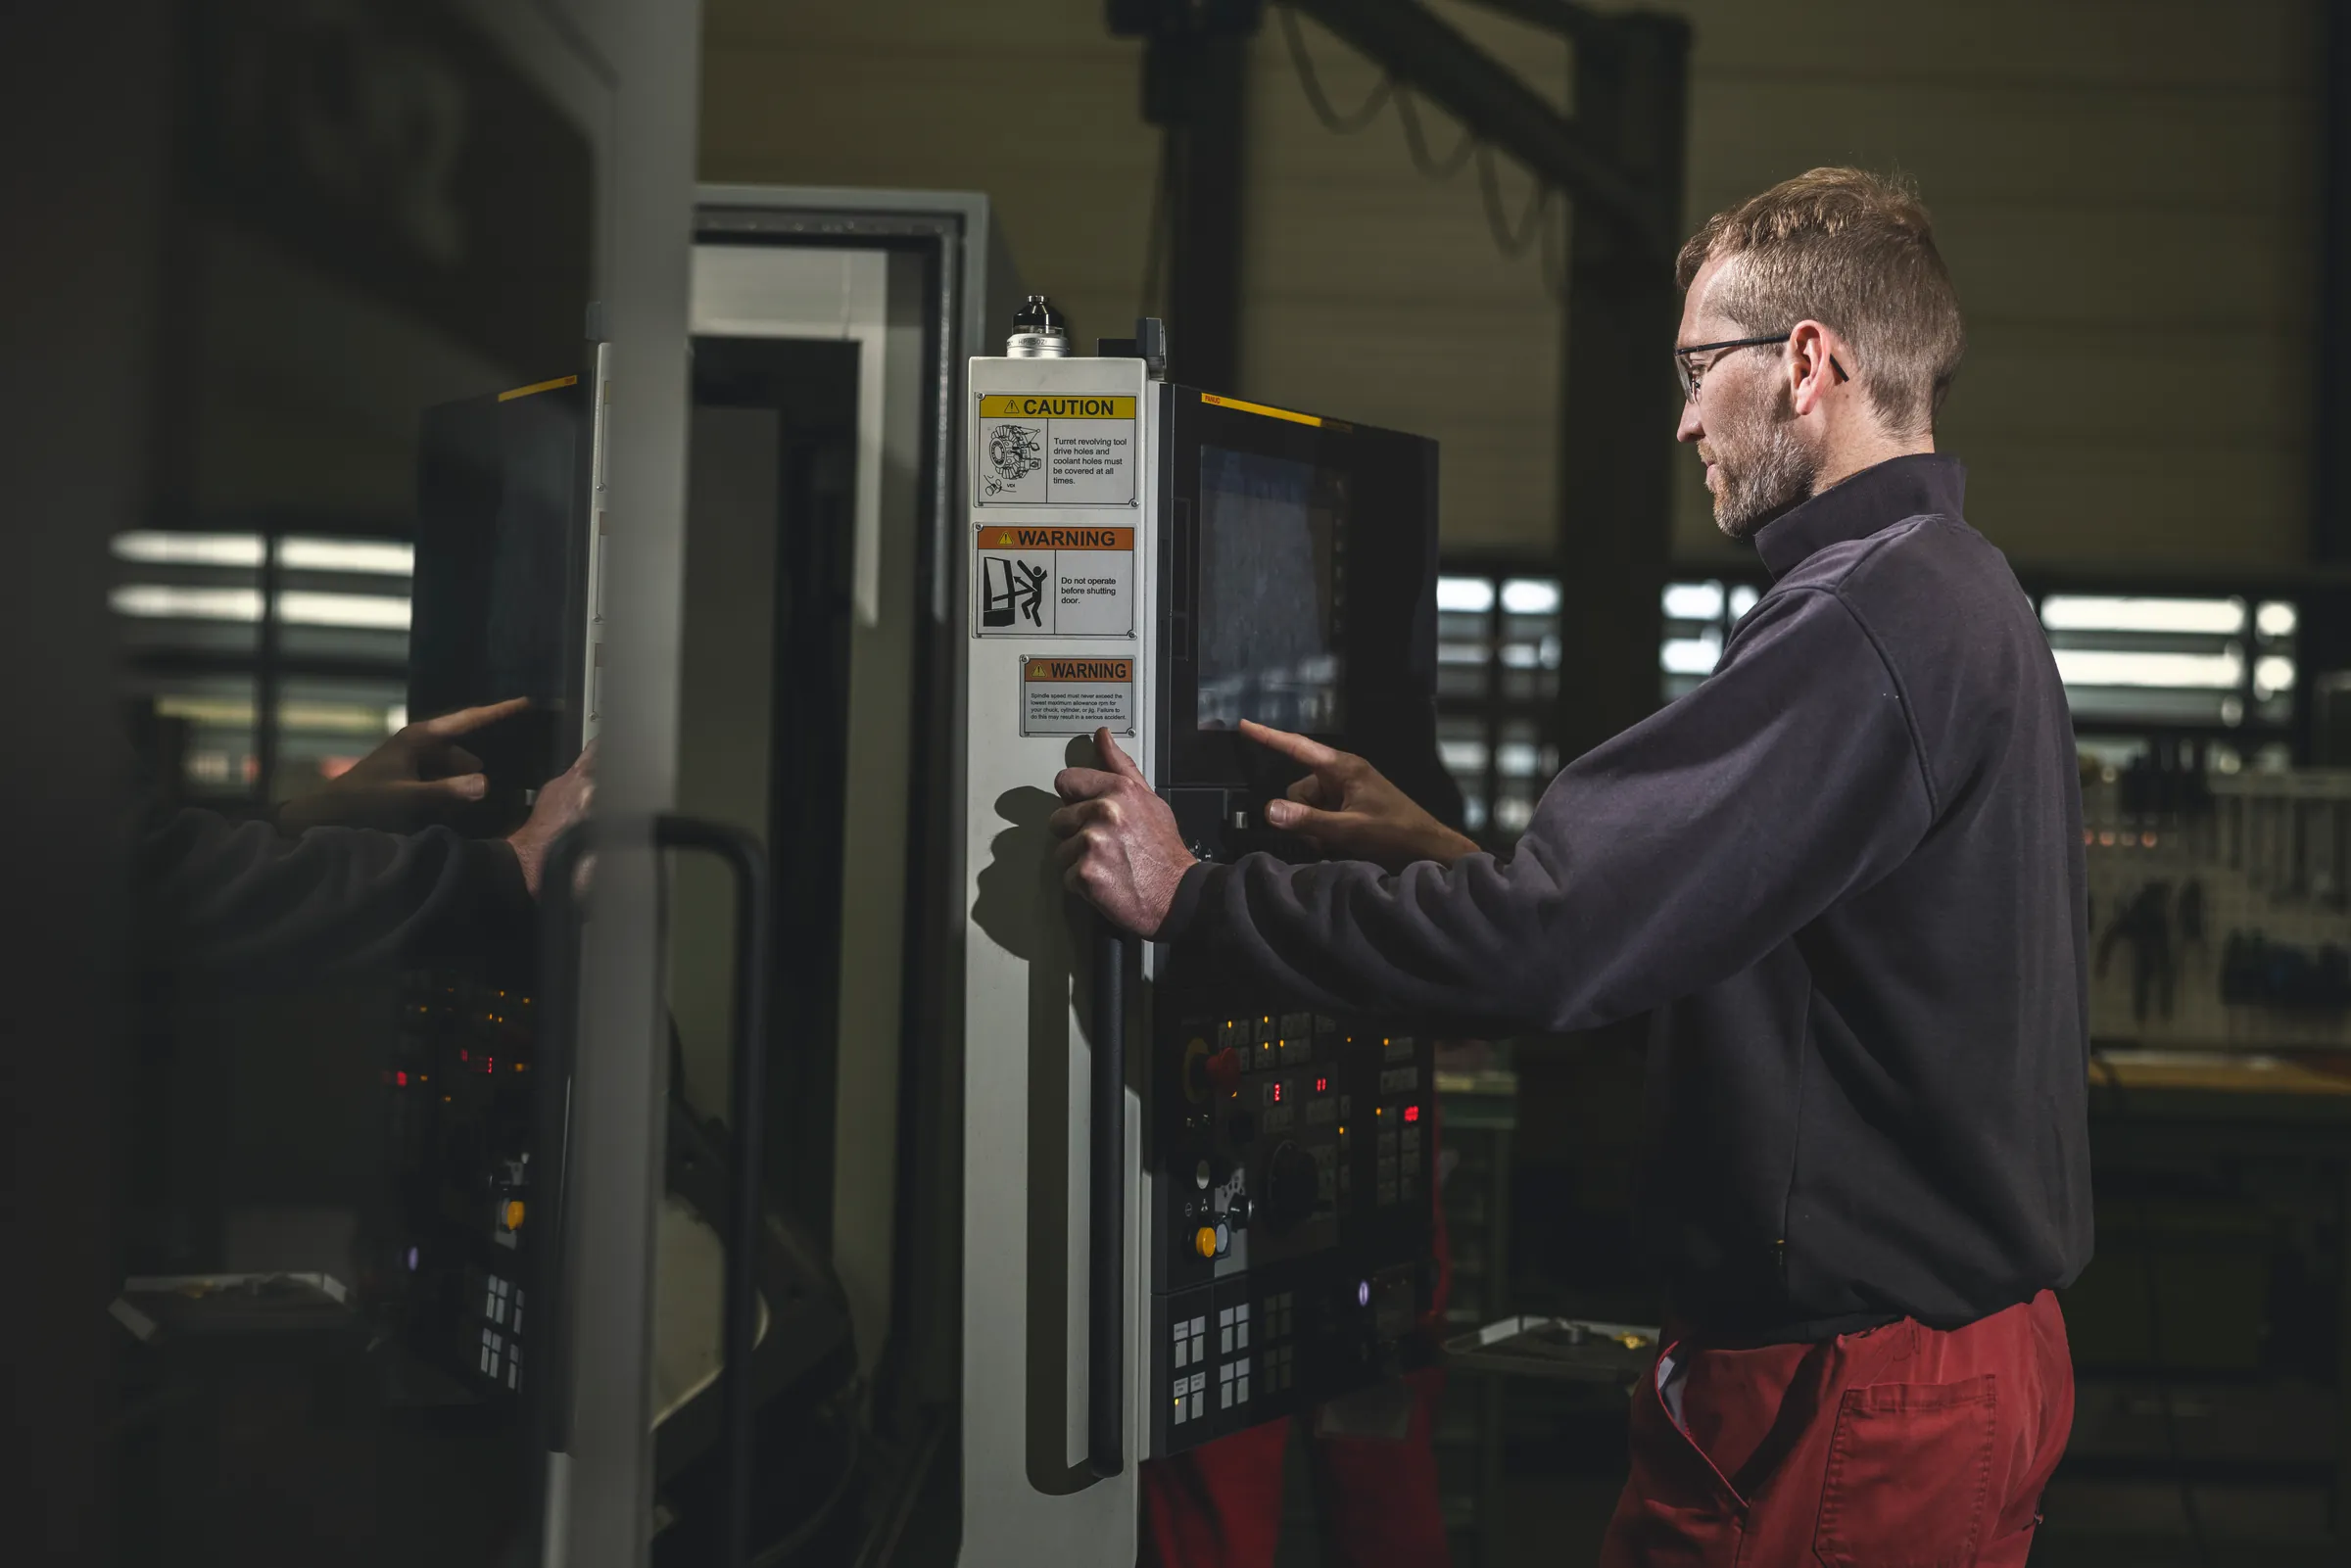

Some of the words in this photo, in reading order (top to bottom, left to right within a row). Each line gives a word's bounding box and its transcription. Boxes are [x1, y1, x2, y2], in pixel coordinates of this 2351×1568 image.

[1024, 400, 1114, 415] CAUTION
[1019, 531, 1116, 546] WARNING
[1051, 663, 1127, 678] WARNING
